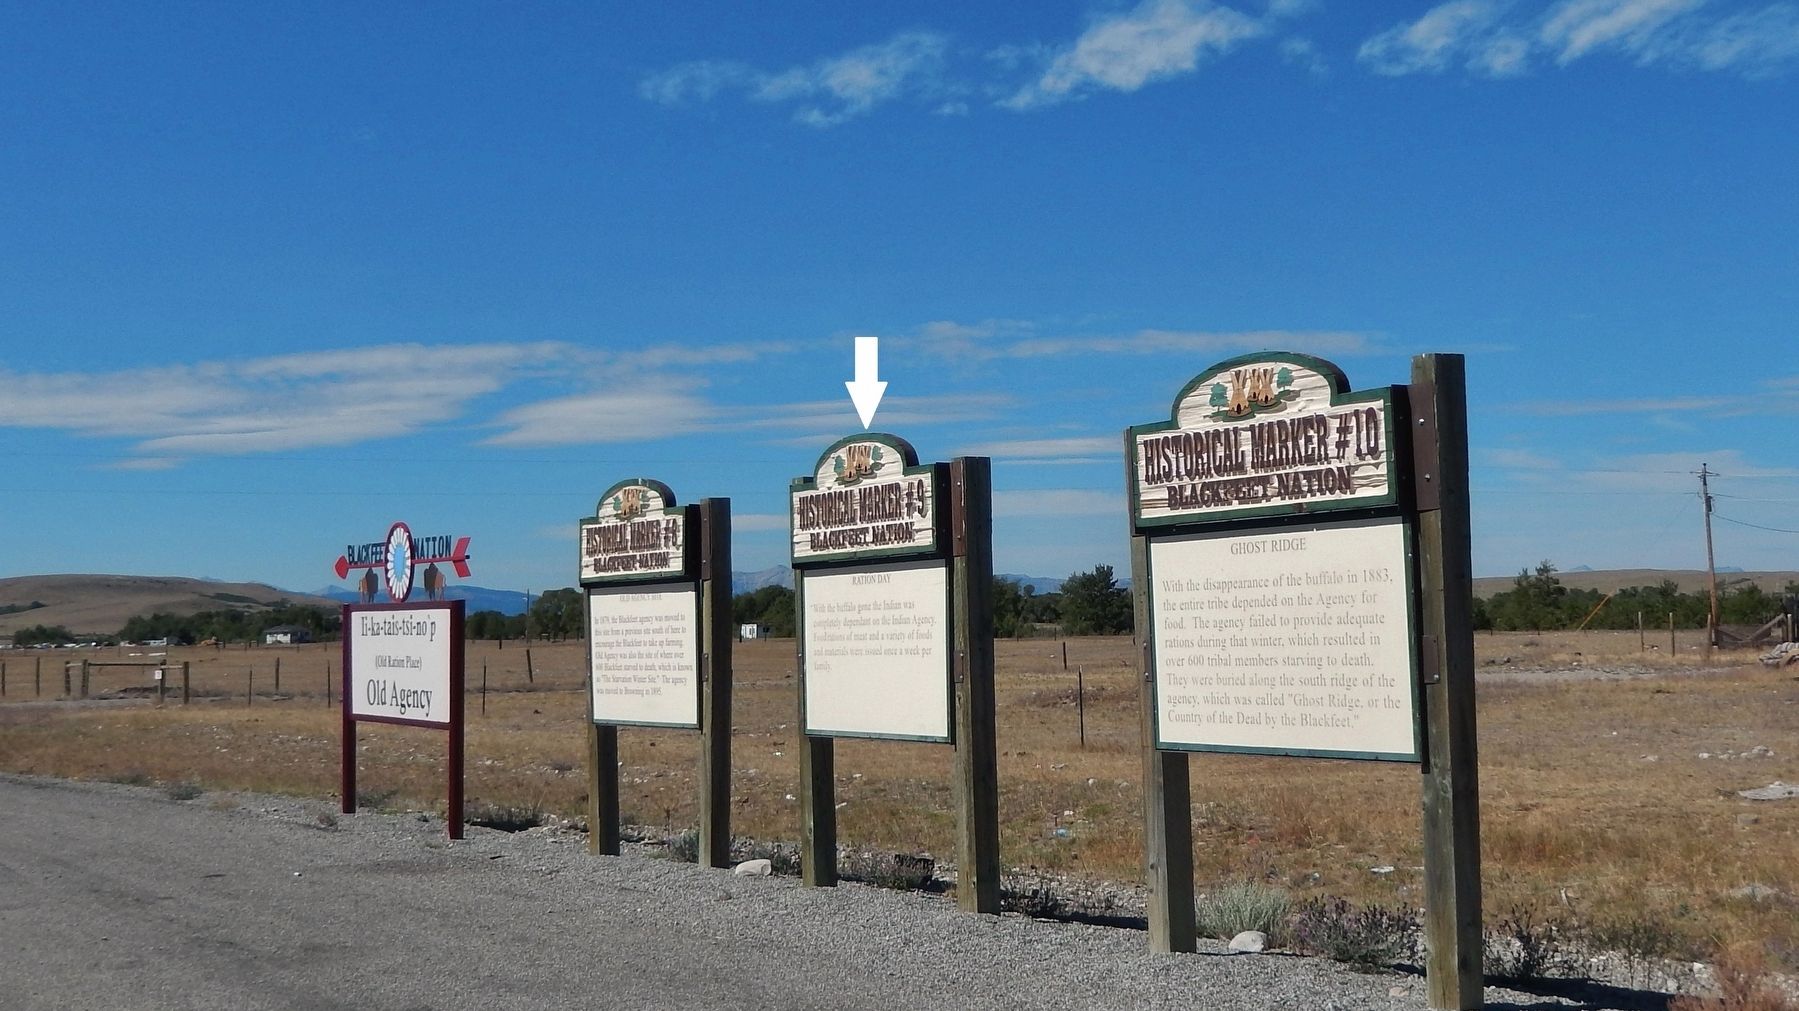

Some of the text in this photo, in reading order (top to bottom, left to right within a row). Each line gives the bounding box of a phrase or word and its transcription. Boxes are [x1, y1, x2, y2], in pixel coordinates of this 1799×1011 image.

[1143, 407, 1381, 485] HISTORICAL MARKER #10
[1276, 465, 1357, 501] NATION
[799, 479, 927, 531] HISTORICAL MARKER #9
[810, 521, 915, 551] BLACKFEET NATION
[1230, 537, 1306, 555] GHOST RIDGE
[414, 535, 452, 560] NATION
[852, 573, 891, 585] RATION DAY
[1162, 579, 1183, 592] With
[1186, 578, 1200, 591] the
[1203, 577, 1269, 593] disappearance
[1272, 573, 1285, 587] of
[1286, 573, 1301, 586] the
[1305, 571, 1343, 585] buffalo
[1347, 569, 1357, 583] in
[1163, 590, 1377, 612] the entire tribe depended on the Agency for
[1192, 616, 1209, 629] The
[1213, 618, 1244, 632] agency
[1249, 613, 1276, 628] failed
[1280, 616, 1290, 627] to
[1293, 612, 1332, 630] provide
[1337, 610, 1385, 629] adequate
[1165, 635, 1194, 648] rations
[1197, 634, 1226, 651] during
[1230, 634, 1248, 647] that
[1288, 632, 1319, 646] which
[1323, 631, 1365, 646] resulted
[1370, 631, 1380, 646] in
[1165, 657, 1184, 667] over
[1187, 655, 1204, 666] 600
[1207, 653, 1231, 667] tribal
[1235, 653, 1279, 667] members
[1282, 652, 1322, 670] starving
[1327, 656, 1337, 666] to
[1166, 672, 1396, 691] They were buried along the south ridge of the
[367, 679, 433, 717] Old Agency
[1203, 691, 1230, 705] which
[1233, 695, 1252, 705] was
[1255, 692, 1285, 706] called
[1367, 698, 1378, 708] or
[1383, 694, 1401, 709] the
[1168, 709, 1202, 727] Country
[1206, 710, 1217, 724] of
[1219, 711, 1233, 724] the
[1236, 711, 1262, 725] Dead
[1265, 712, 1276, 729] by
[1281, 712, 1297, 726] the
